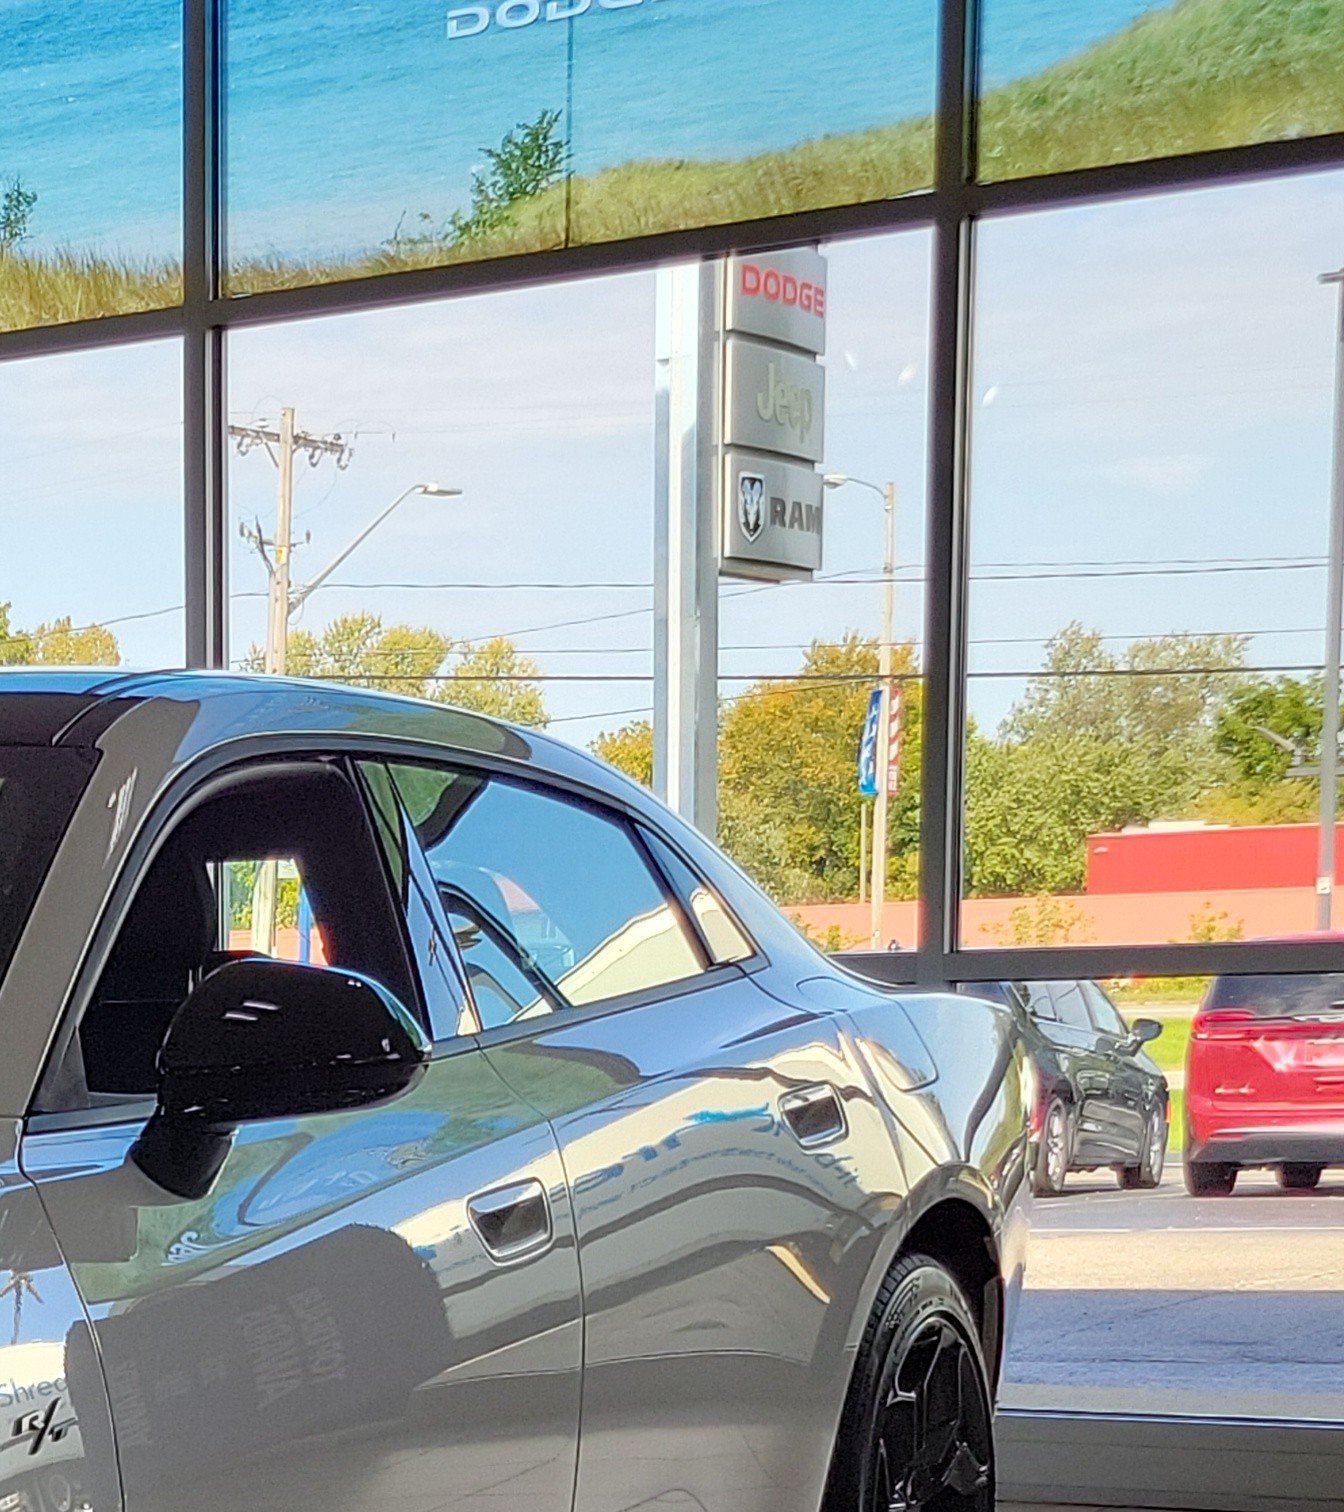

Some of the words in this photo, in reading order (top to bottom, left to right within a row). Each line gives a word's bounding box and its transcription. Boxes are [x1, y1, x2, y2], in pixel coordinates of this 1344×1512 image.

[446, 0, 654, 39] DOD
[741, 263, 825, 319] DODGE
[756, 362, 813, 444] Jeep
[11, 1396, 79, 1456] R/T
